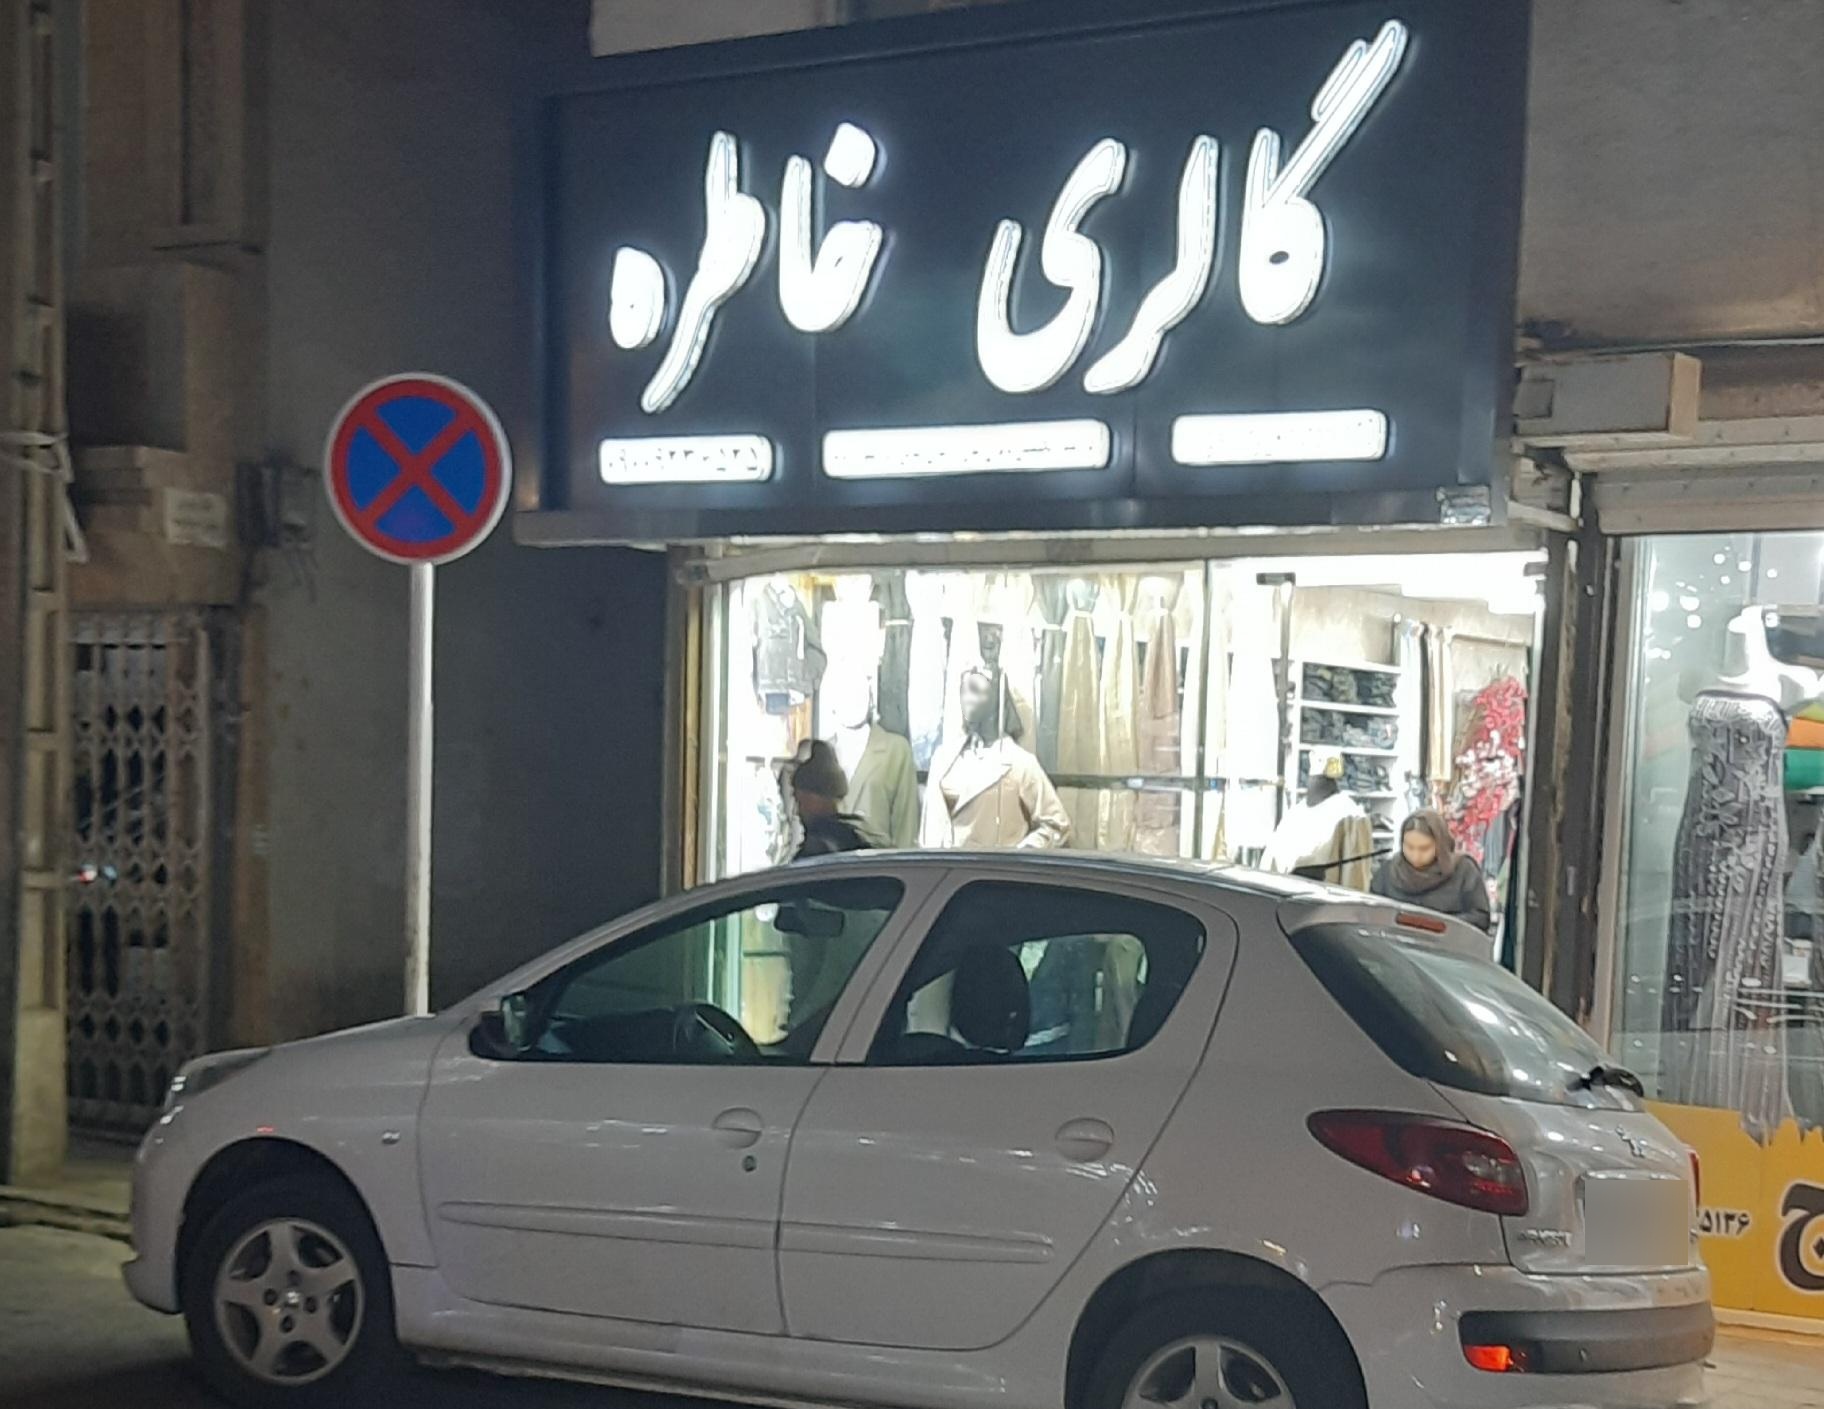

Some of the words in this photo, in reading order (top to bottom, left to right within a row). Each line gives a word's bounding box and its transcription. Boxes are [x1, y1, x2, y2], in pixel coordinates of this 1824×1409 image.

[609, 122, 882, 412] خاطره
[978, 20, 1407, 393] گالری
[1696, 1208, 1750, 1236] ۵۱۳۶
